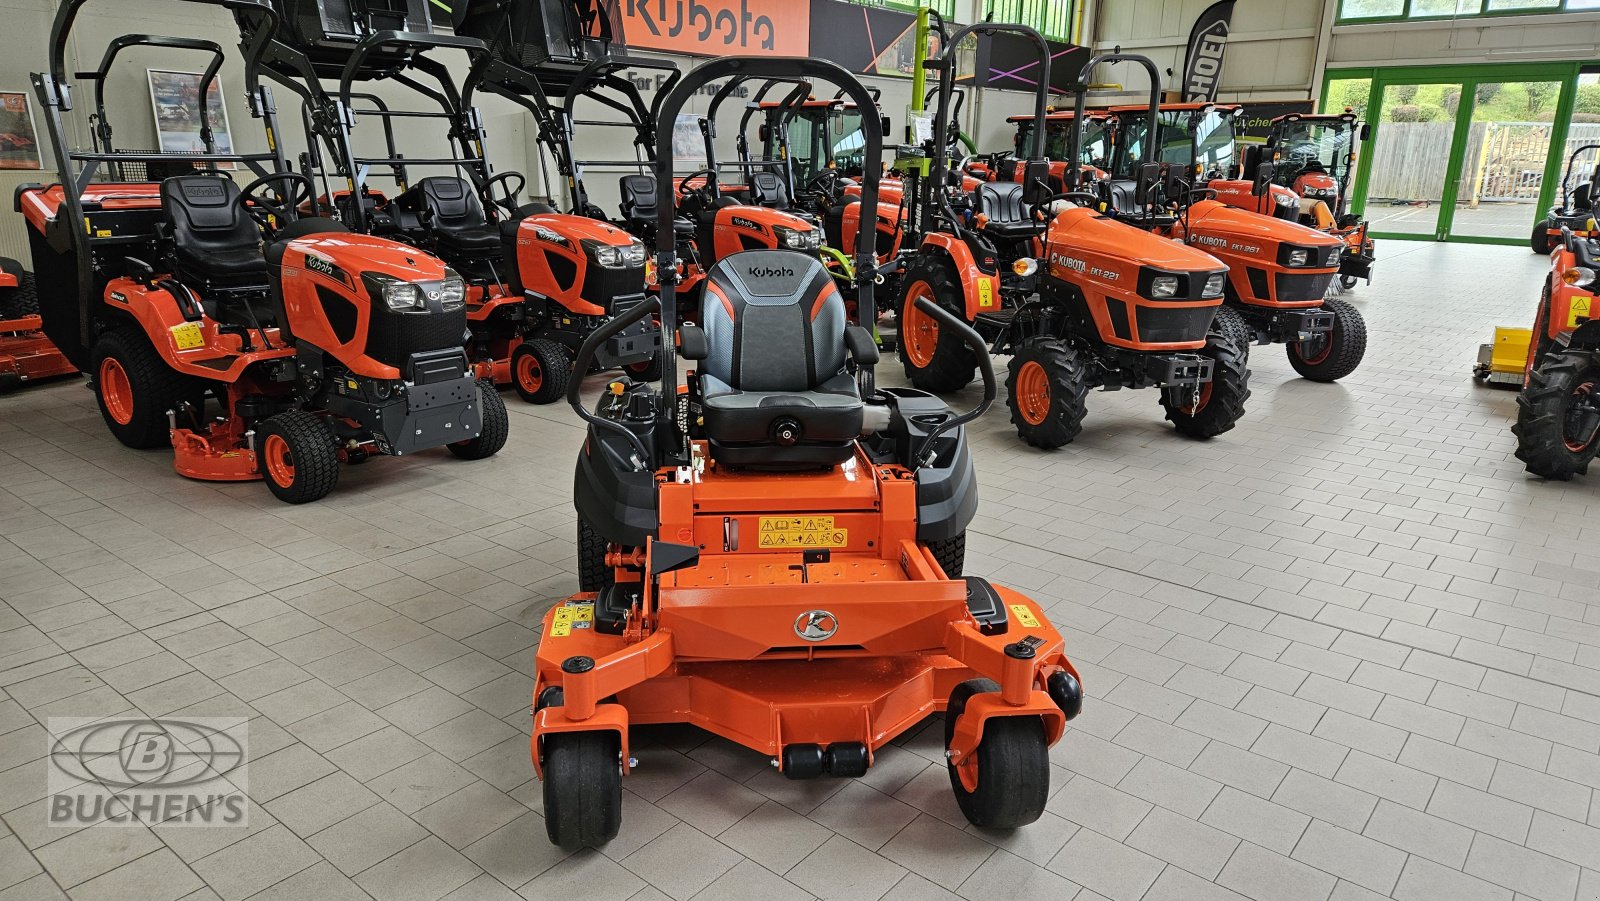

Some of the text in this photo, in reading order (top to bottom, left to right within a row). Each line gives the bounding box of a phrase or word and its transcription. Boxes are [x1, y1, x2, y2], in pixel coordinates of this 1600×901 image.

[626, 0, 775, 50] Kubota
[734, 217, 753, 228] Kubota
[1199, 235, 1227, 248] KUBOTA
[308, 255, 333, 275] Kubota
[749, 266, 794, 277] Kubota
[1059, 255, 1120, 281] KUBOTA EK1-221
